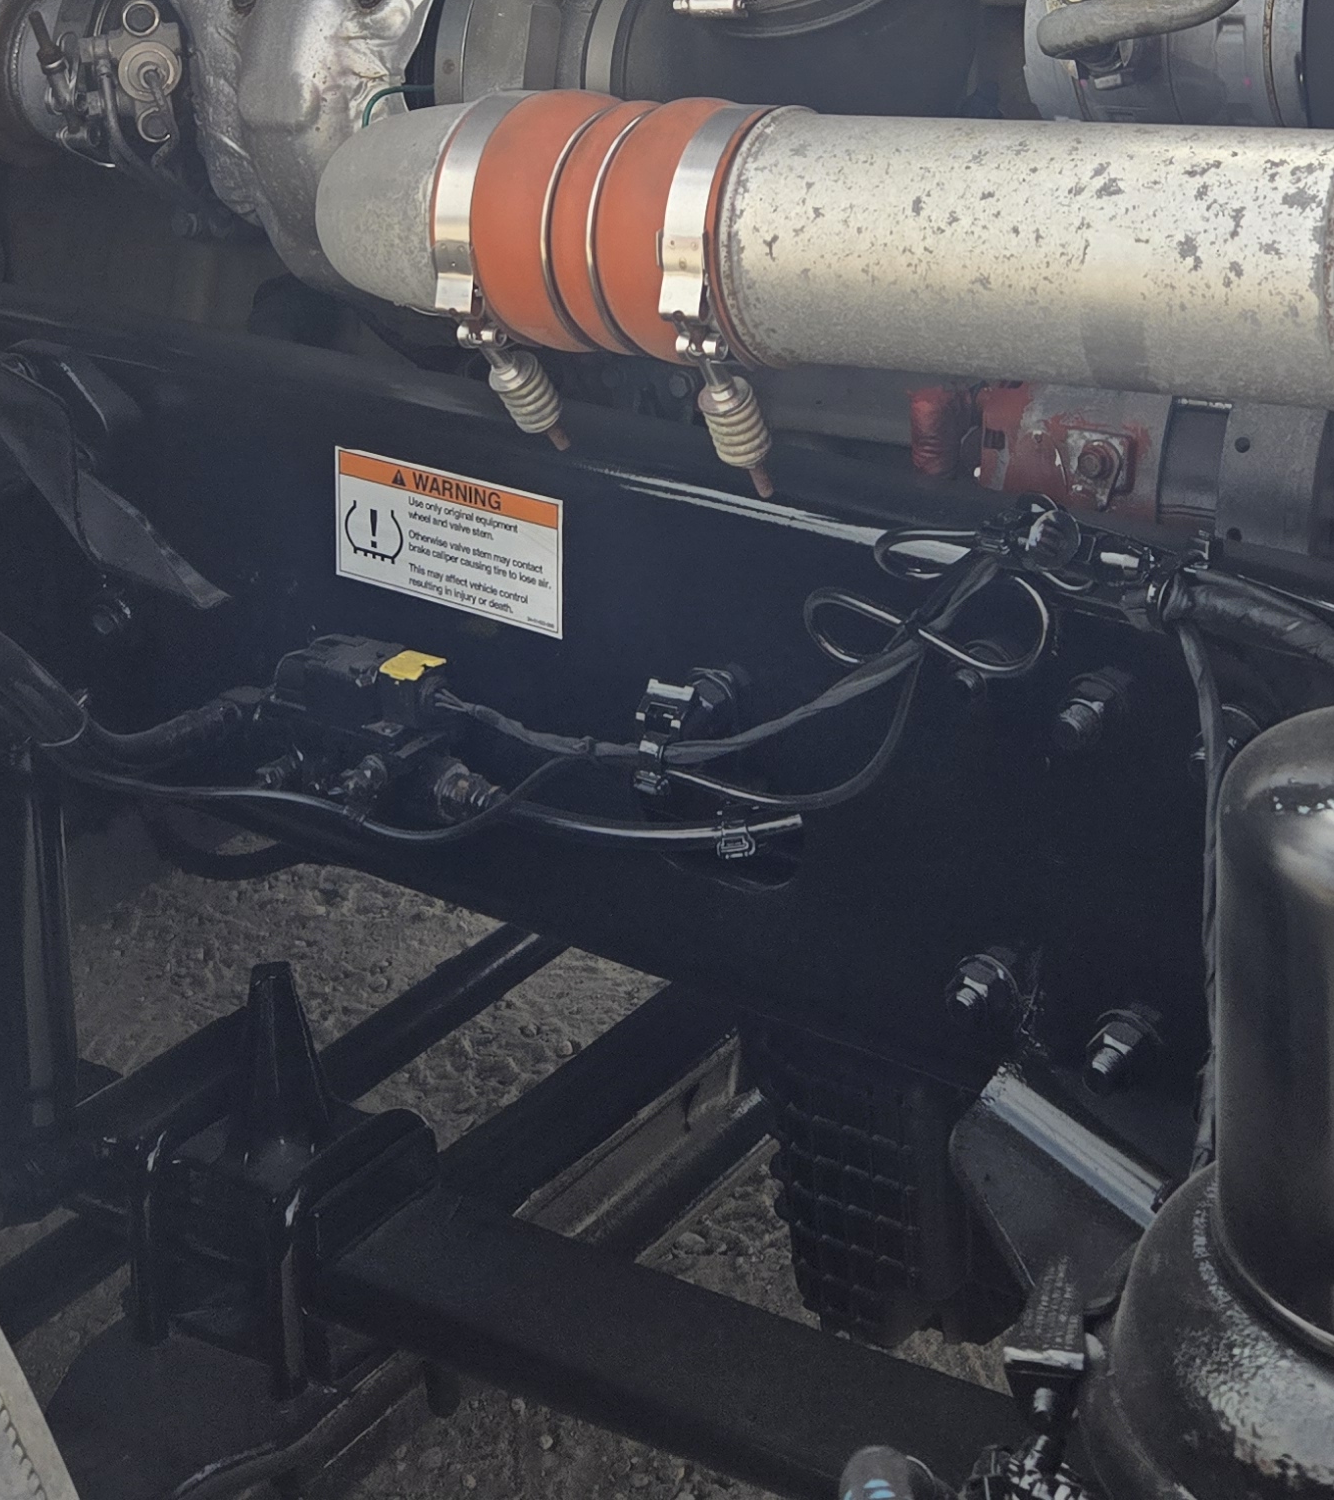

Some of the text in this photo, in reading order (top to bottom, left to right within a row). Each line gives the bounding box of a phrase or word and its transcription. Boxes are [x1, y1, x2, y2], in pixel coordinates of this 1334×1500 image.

[412, 471, 502, 512] WARNING
[408, 496, 518, 534] Use only original equipment
[408, 510, 494, 541] wheel and valve stem.
[408, 530, 543, 574] Otherwise valve stem may contact
[408, 542, 552, 590] brake caliper causing tire to lose air.
[409, 563, 529, 605] This may affect vehicle control
[409, 577, 514, 614] resulting in injury or death.
